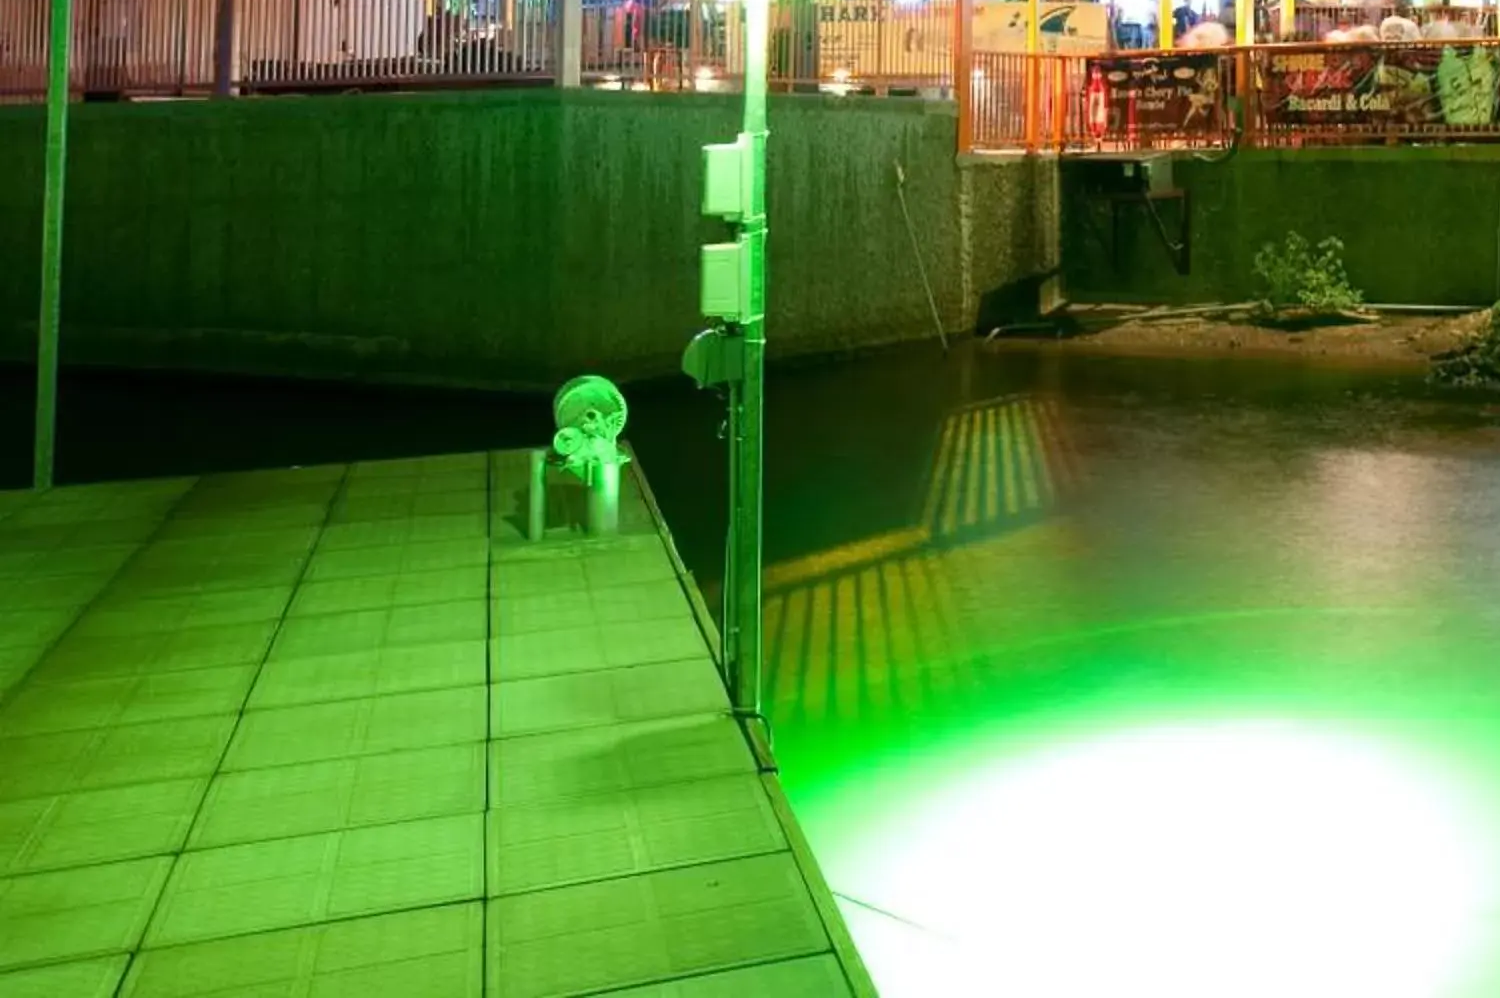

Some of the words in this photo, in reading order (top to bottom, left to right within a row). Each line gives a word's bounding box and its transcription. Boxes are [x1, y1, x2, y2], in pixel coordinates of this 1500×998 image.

[1286, 93, 1341, 111] Bacardi
[1345, 92, 1358, 111] &
[1360, 91, 1391, 112] Cola
